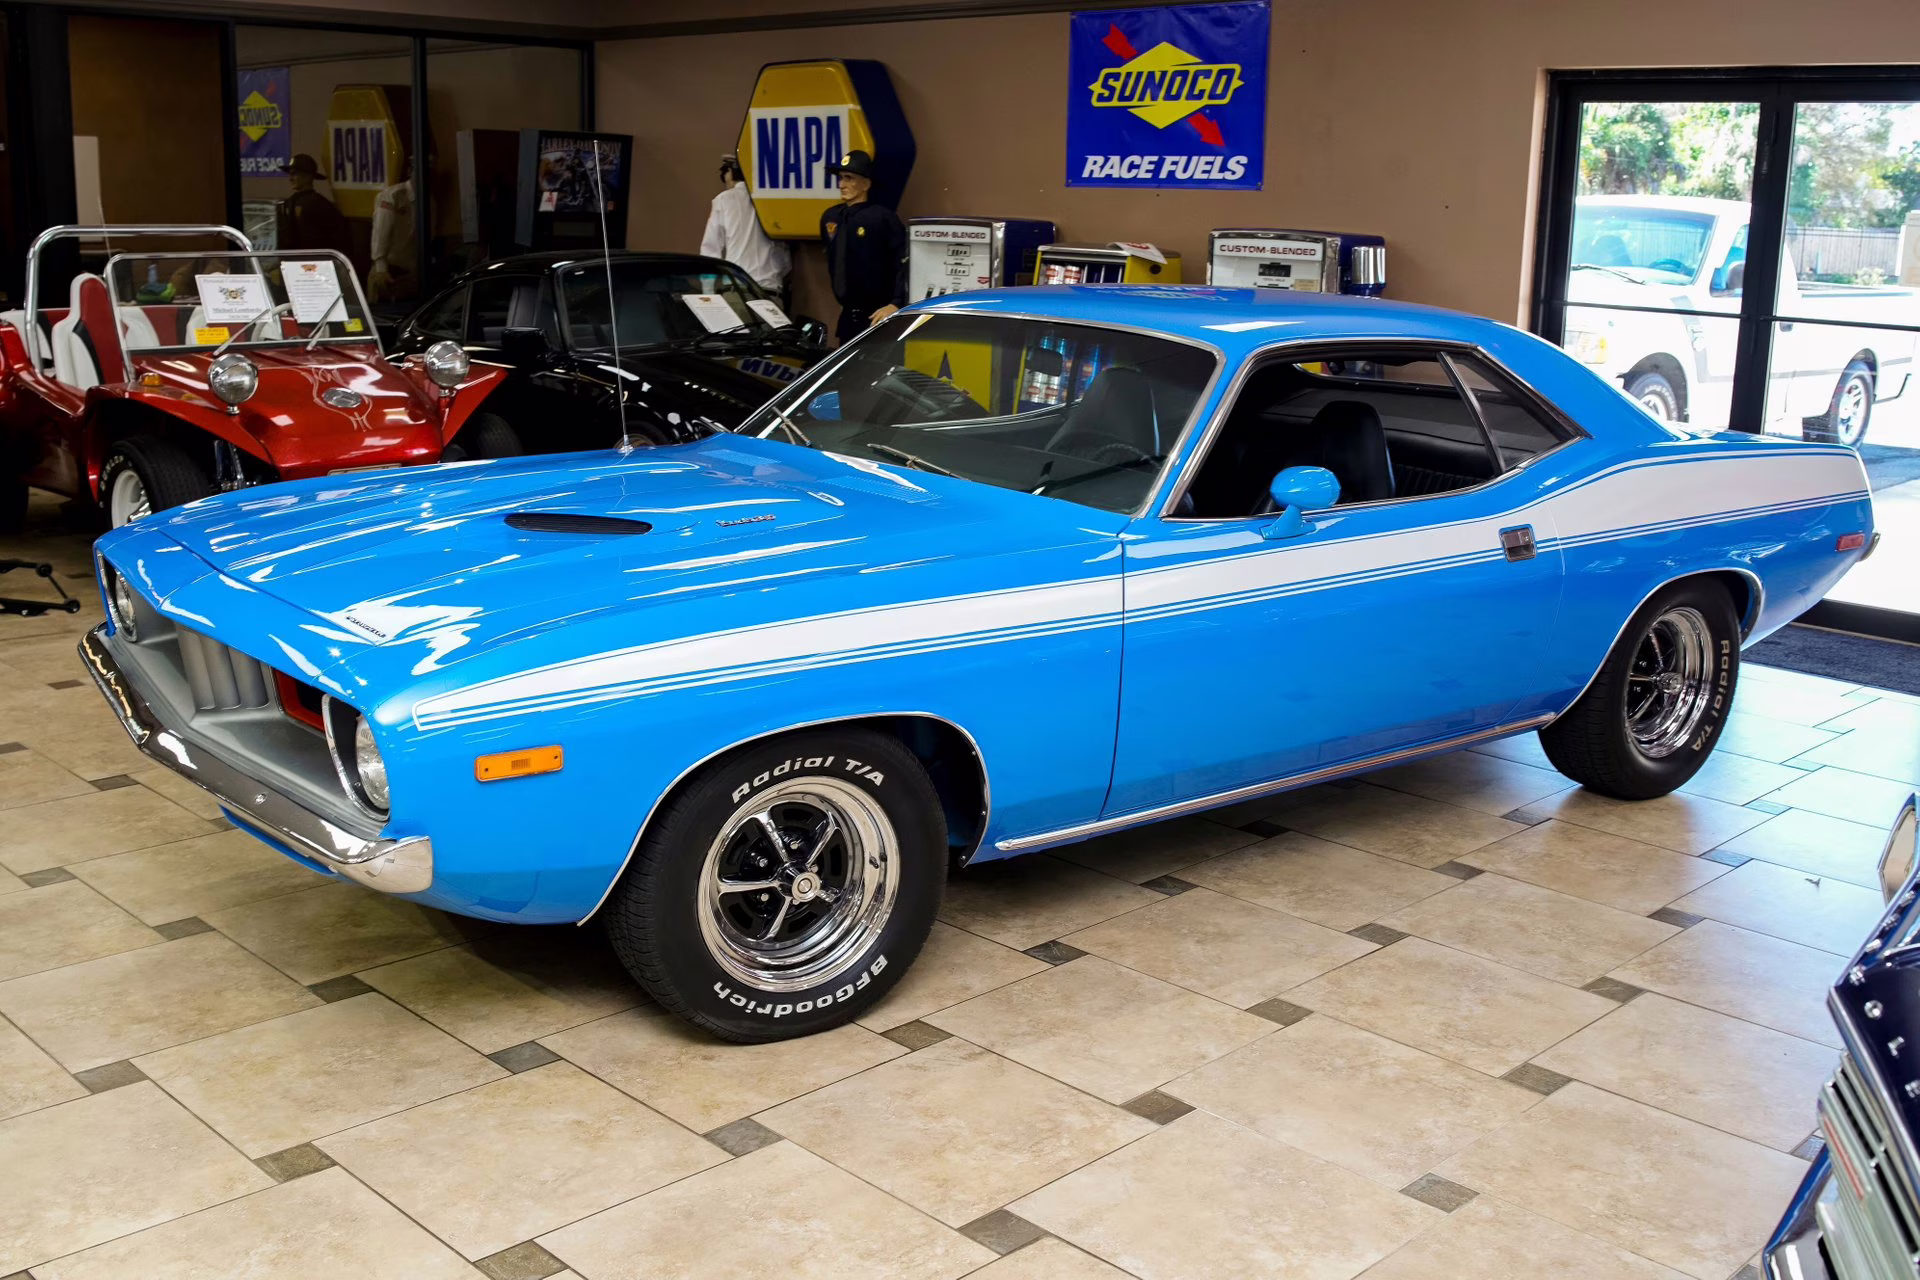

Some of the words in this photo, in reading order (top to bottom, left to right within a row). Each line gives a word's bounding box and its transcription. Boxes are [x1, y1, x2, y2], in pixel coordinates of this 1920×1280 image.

[1096, 68, 1237, 103] SUNOCO
[757, 116, 843, 189] NAPA
[1081, 155, 1159, 179] RACE
[1158, 155, 1248, 181] FUELS
[914, 230, 987, 240] CUSTOM-BLENDED
[1219, 244, 1317, 256] CUSTOM-BLENDED
[1713, 639, 1731, 719] Radial
[1691, 724, 1714, 751] T/A
[731, 755, 836, 804] Radial
[844, 758, 886, 787] T/A
[712, 953, 889, 1019] BFGoodrich
